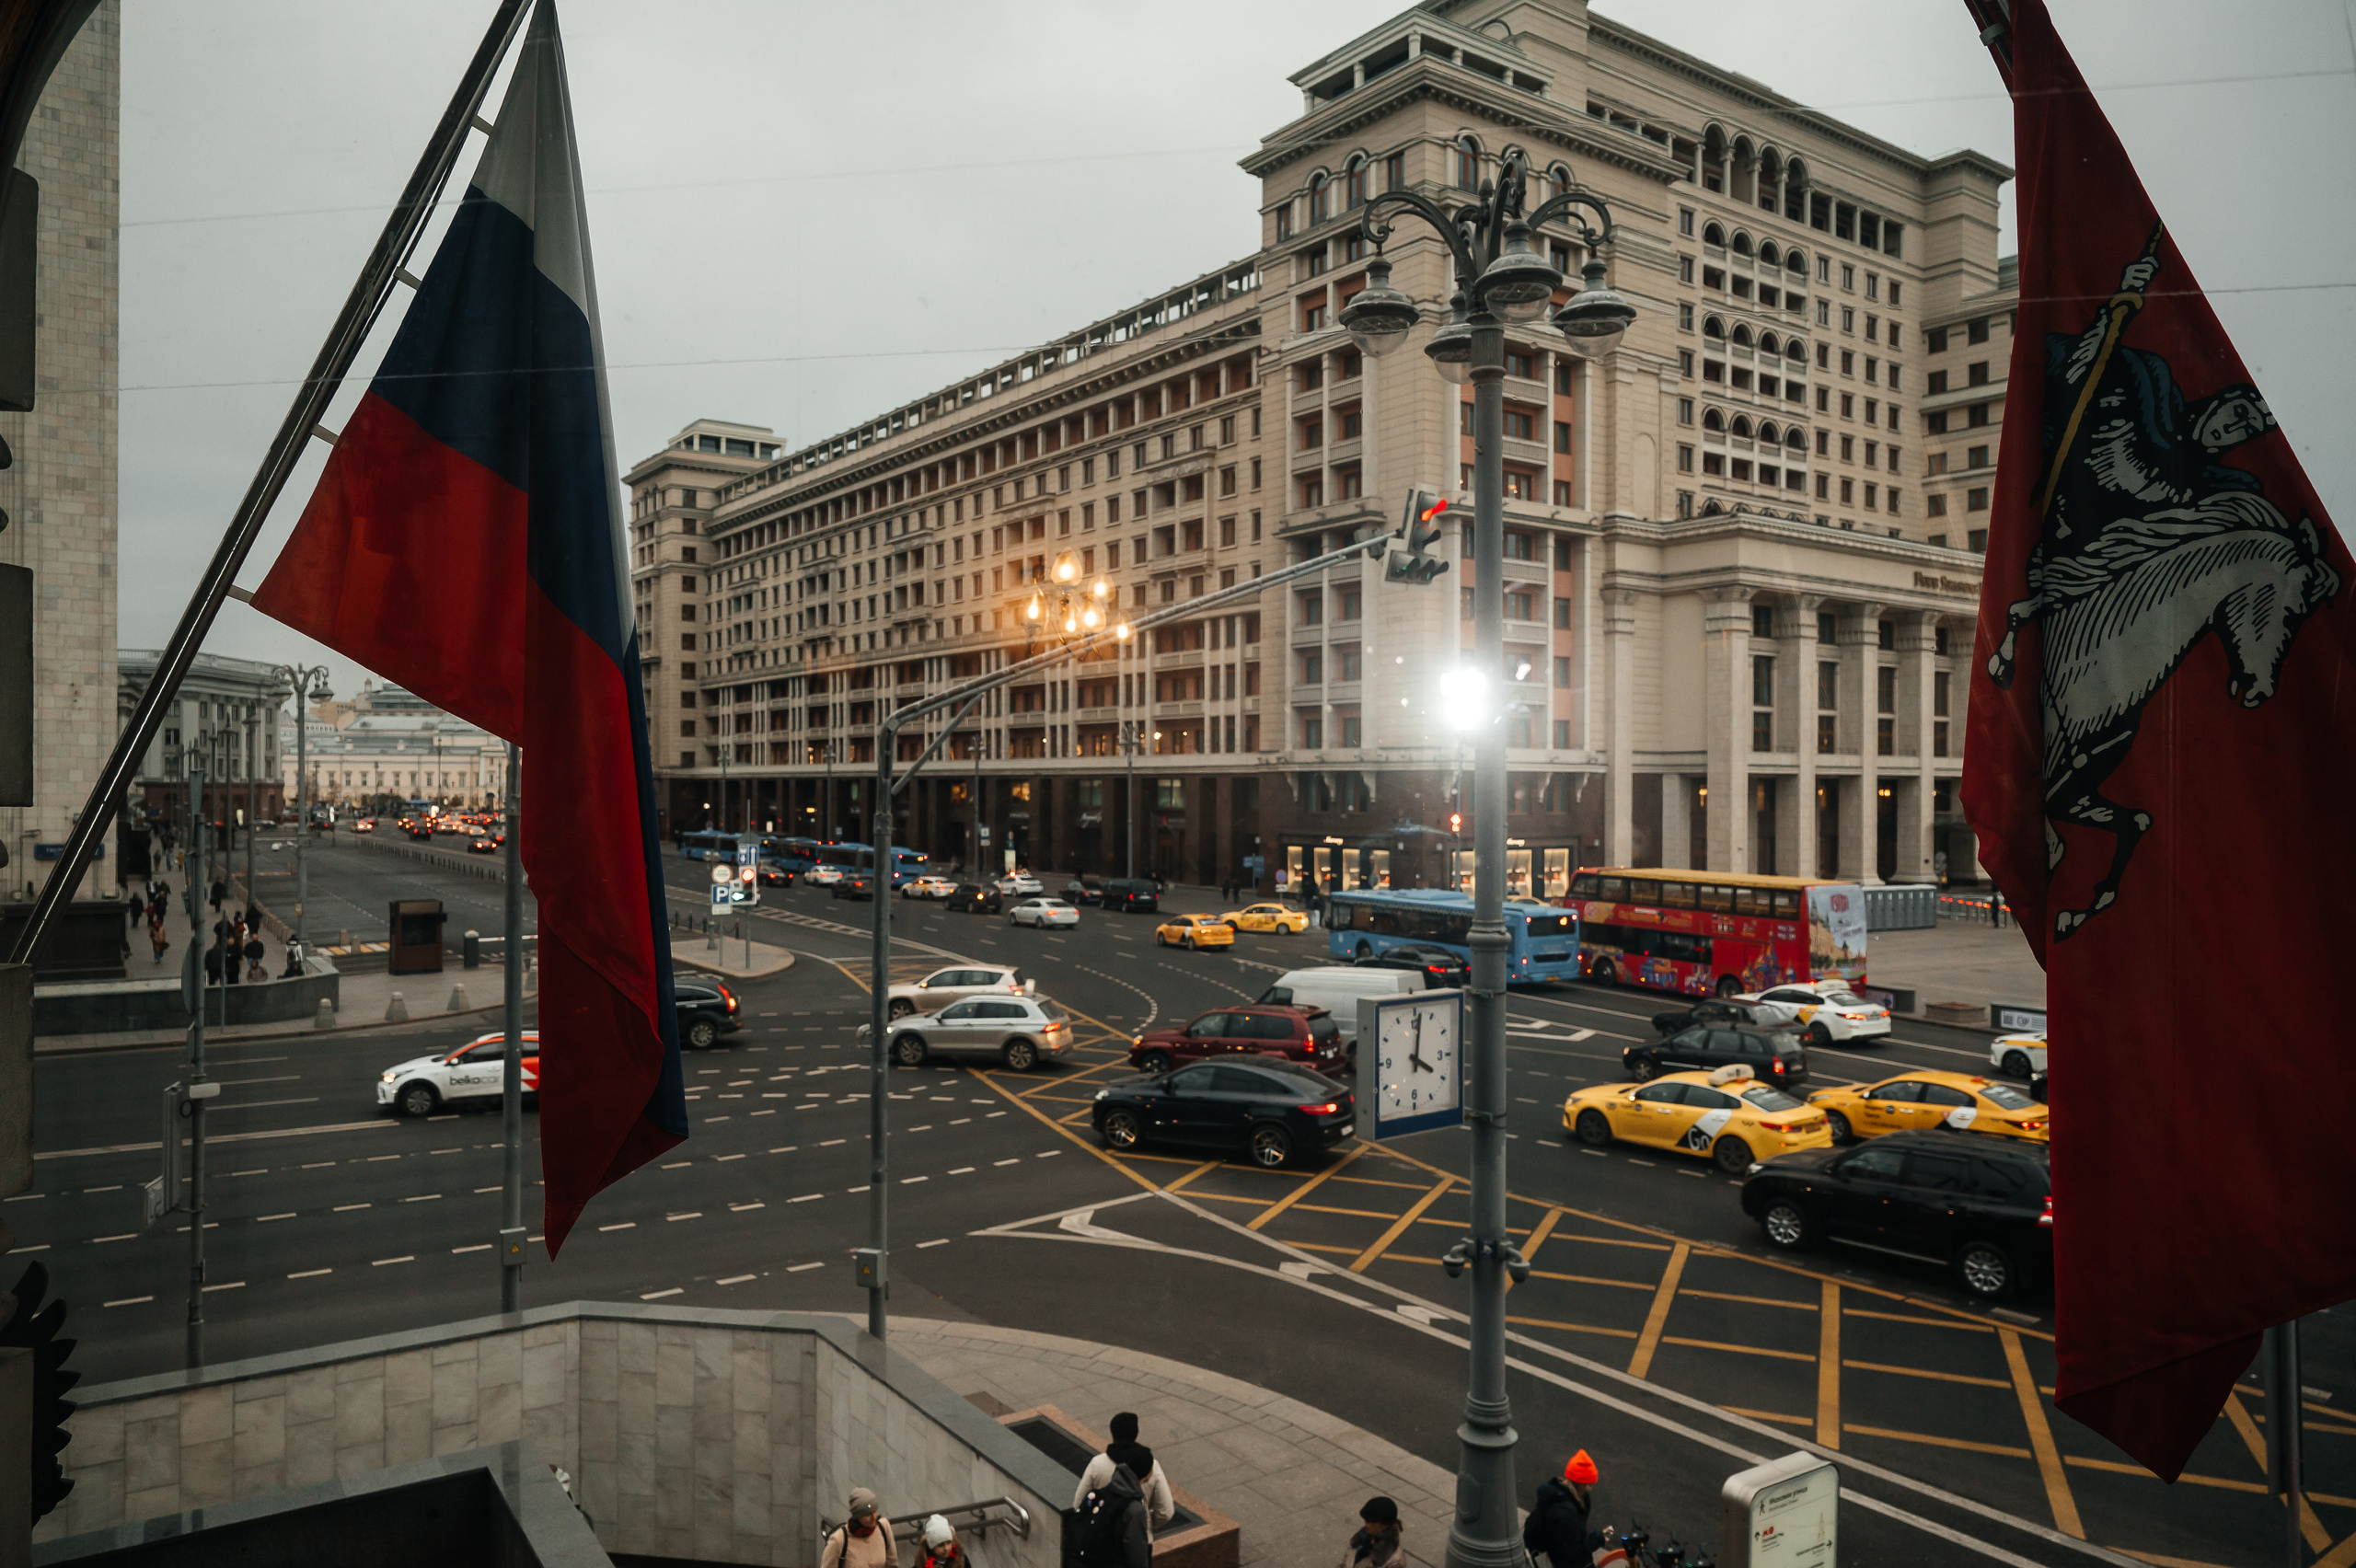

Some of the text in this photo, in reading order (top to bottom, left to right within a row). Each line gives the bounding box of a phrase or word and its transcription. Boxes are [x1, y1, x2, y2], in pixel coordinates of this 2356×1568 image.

[716, 886, 730, 903] P
[1437, 1050, 1443, 1061] 3
[1385, 1057, 1392, 1069] 9
[1411, 1089, 1417, 1100] 6
[1687, 1127, 1710, 1151] Go
